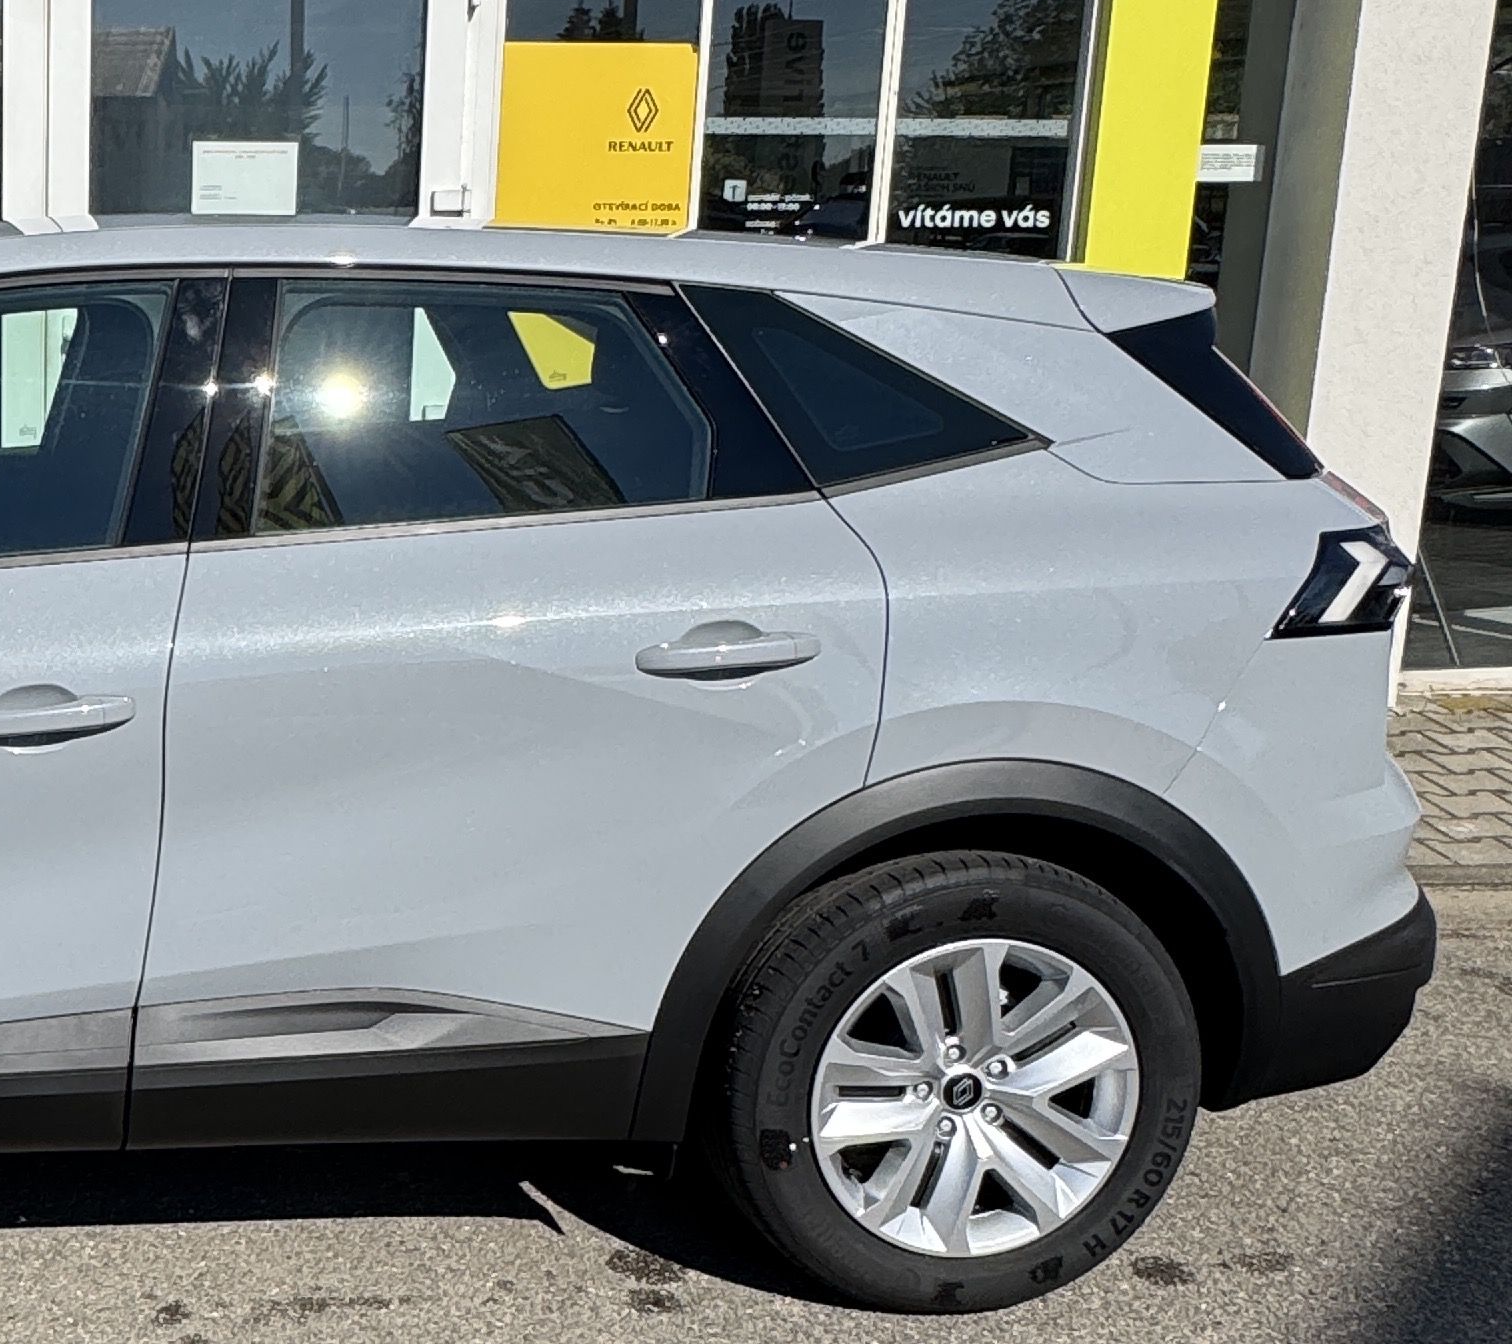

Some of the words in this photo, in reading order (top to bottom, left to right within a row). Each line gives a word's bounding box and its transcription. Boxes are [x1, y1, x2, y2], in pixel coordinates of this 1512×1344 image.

[608, 140, 674, 152] RENAULT
[898, 204, 997, 228] vítáme
[1001, 204, 1051, 228] vás
[767, 961, 853, 1105] EcoContact
[851, 939, 870, 962] 7
[1144, 1099, 1188, 1187] 215/60
[1126, 1188, 1151, 1209] R
[1110, 1209, 1135, 1236] 17
[1082, 1233, 1107, 1257] H
